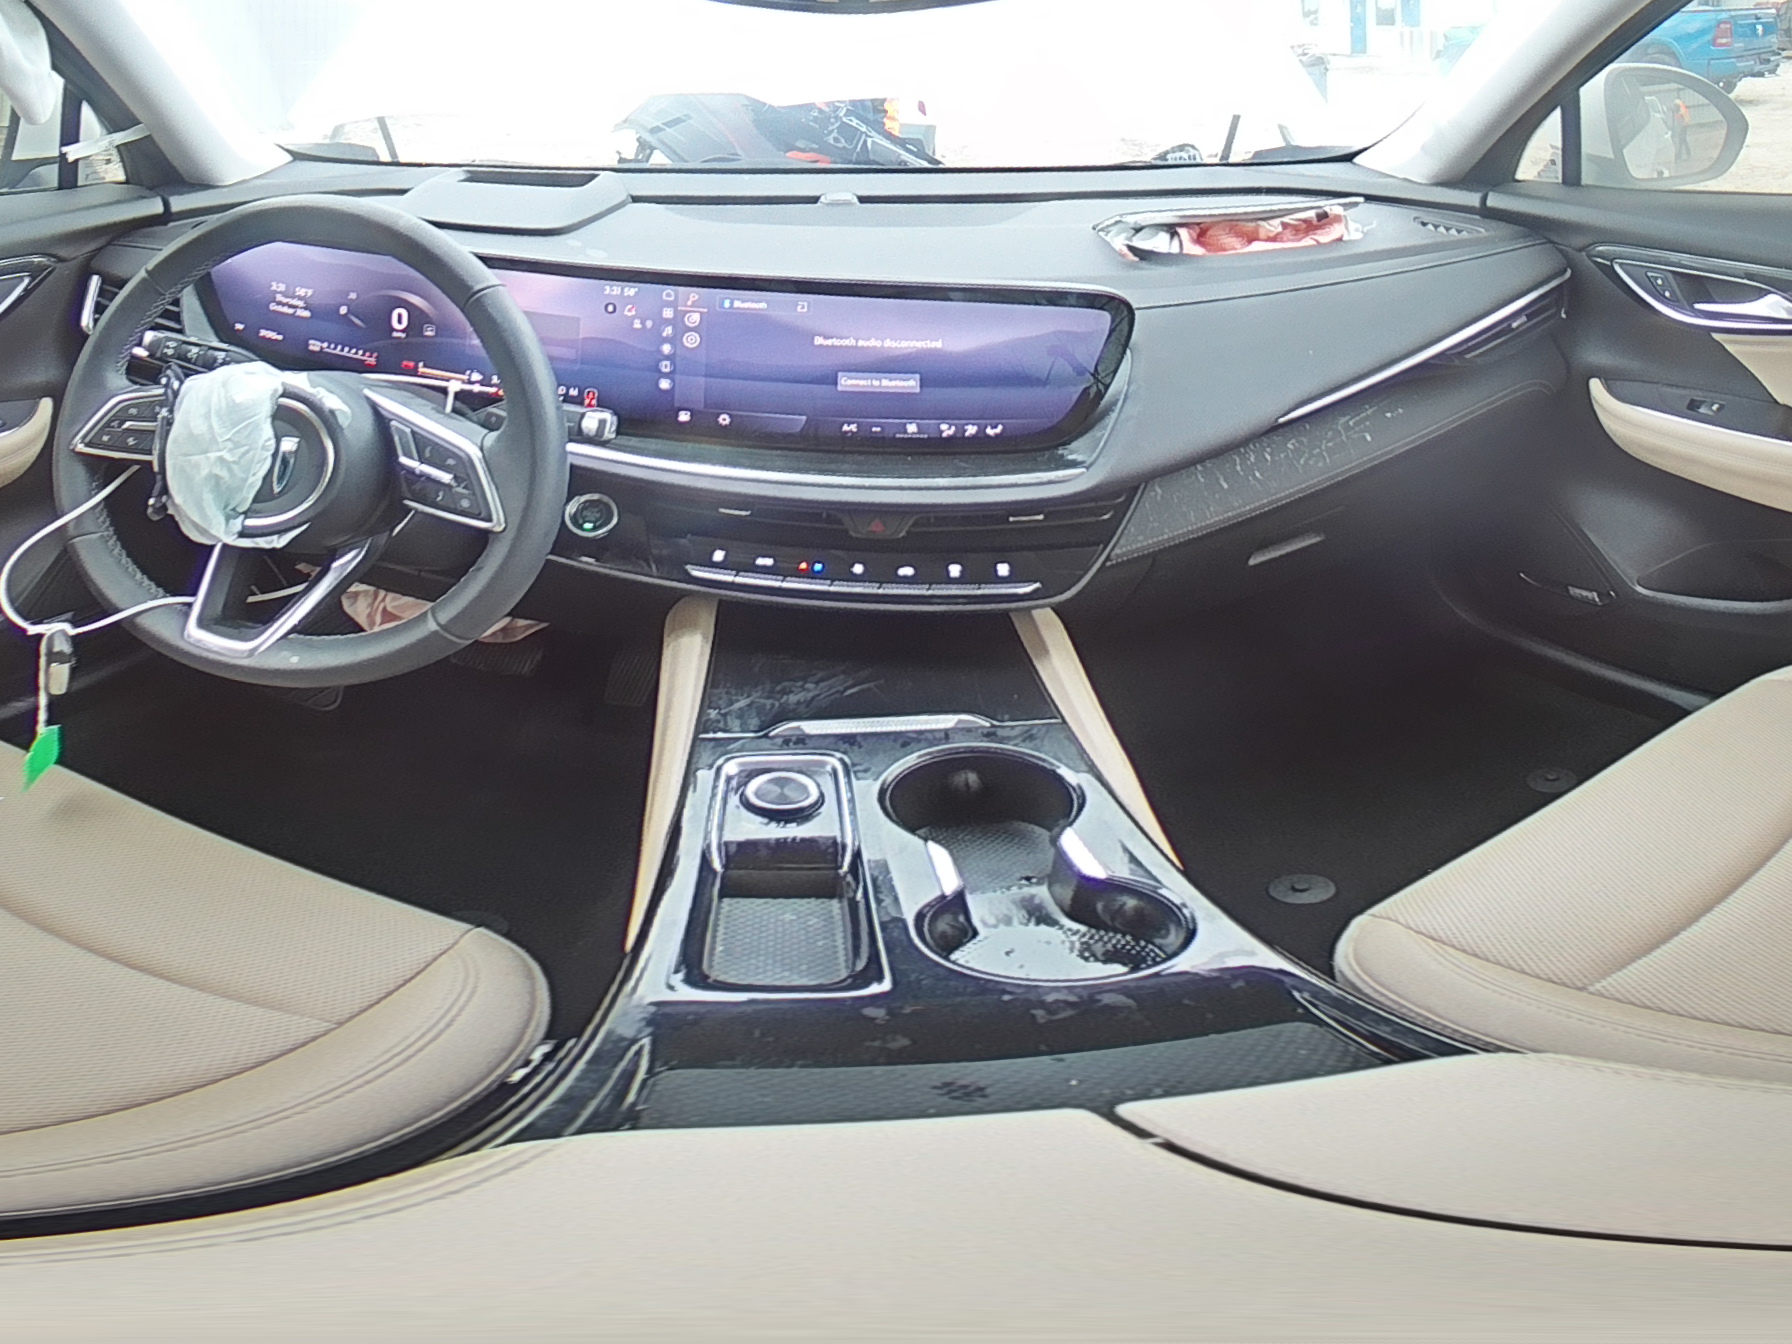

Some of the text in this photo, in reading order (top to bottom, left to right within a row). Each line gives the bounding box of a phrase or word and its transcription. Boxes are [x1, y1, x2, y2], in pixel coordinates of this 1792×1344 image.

[390, 307, 409, 331] 0
[813, 335, 943, 349] Bluetooth audio disconnected
[841, 376, 872, 387] Connect
